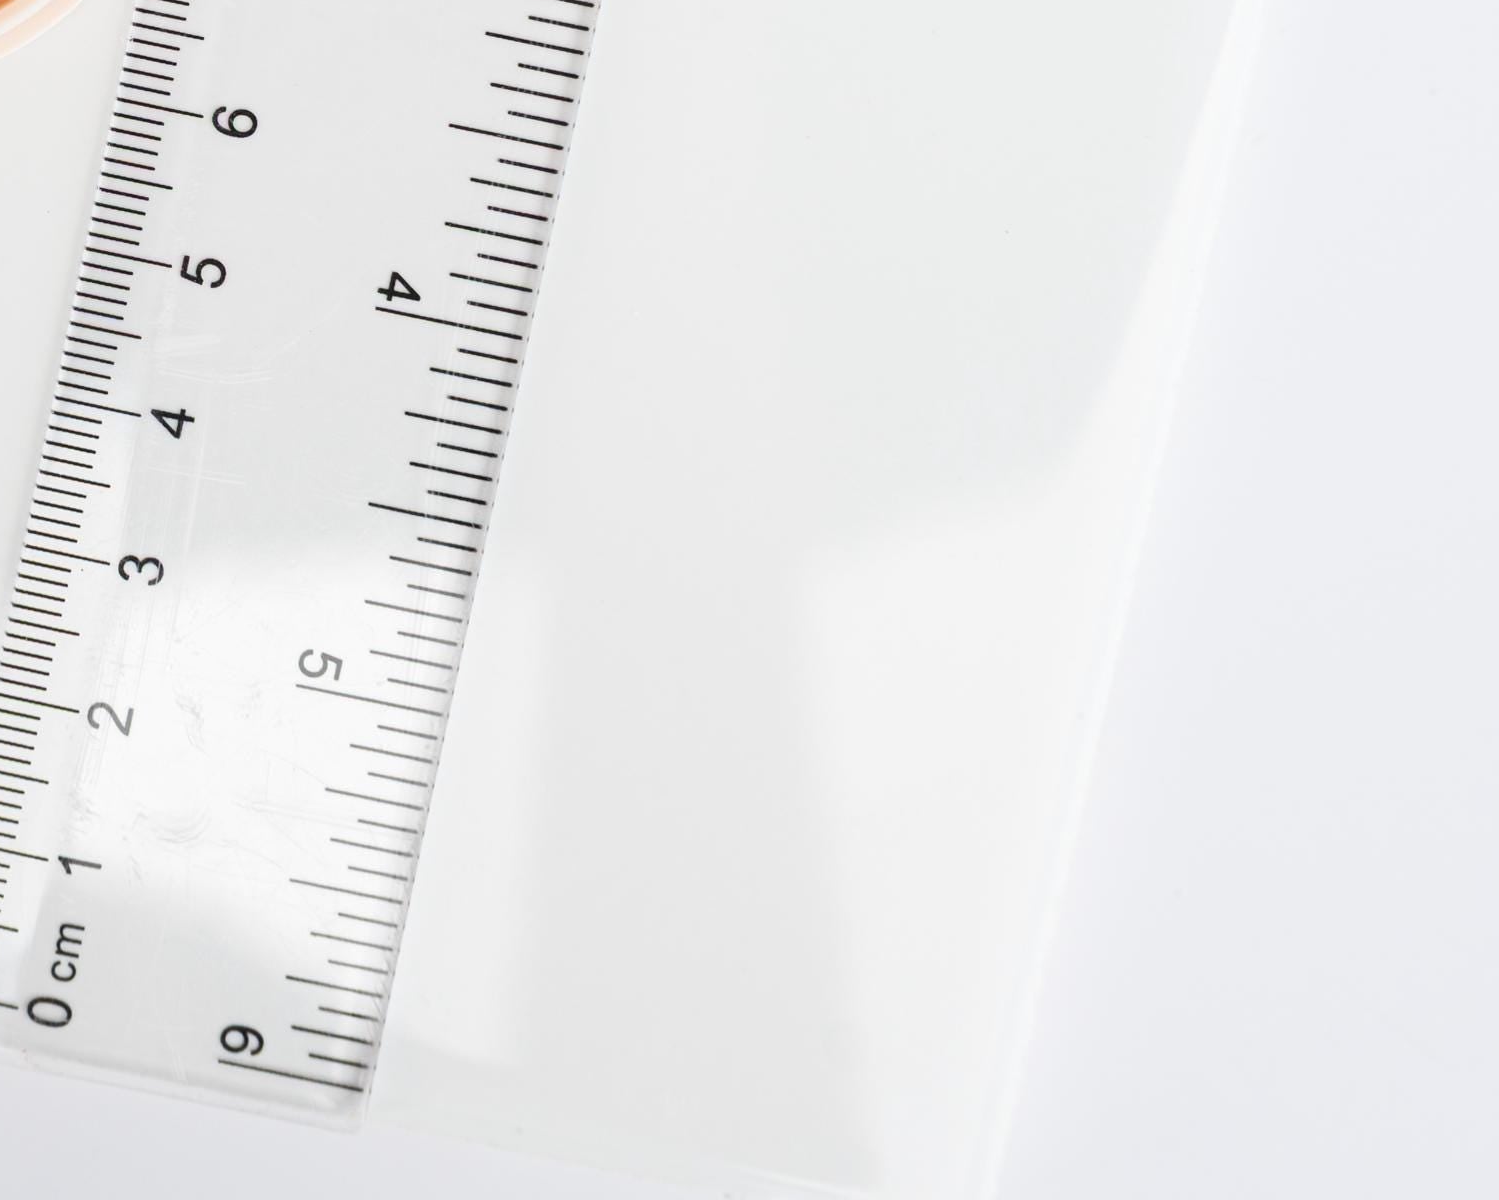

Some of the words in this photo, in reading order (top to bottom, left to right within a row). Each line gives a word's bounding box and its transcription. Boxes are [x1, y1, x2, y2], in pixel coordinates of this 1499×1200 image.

[211, 105, 258, 139] 6
[179, 255, 227, 289] 5
[376, 271, 421, 302] 4
[150, 408, 196, 440] 4
[117, 554, 165, 586] 3
[298, 648, 344, 681] 5
[86, 701, 134, 737] 2
[57, 855, 102, 875] 1
[26, 996, 73, 1028] 0
[50, 923, 86, 983] cm
[219, 1024, 265, 1056] 6
